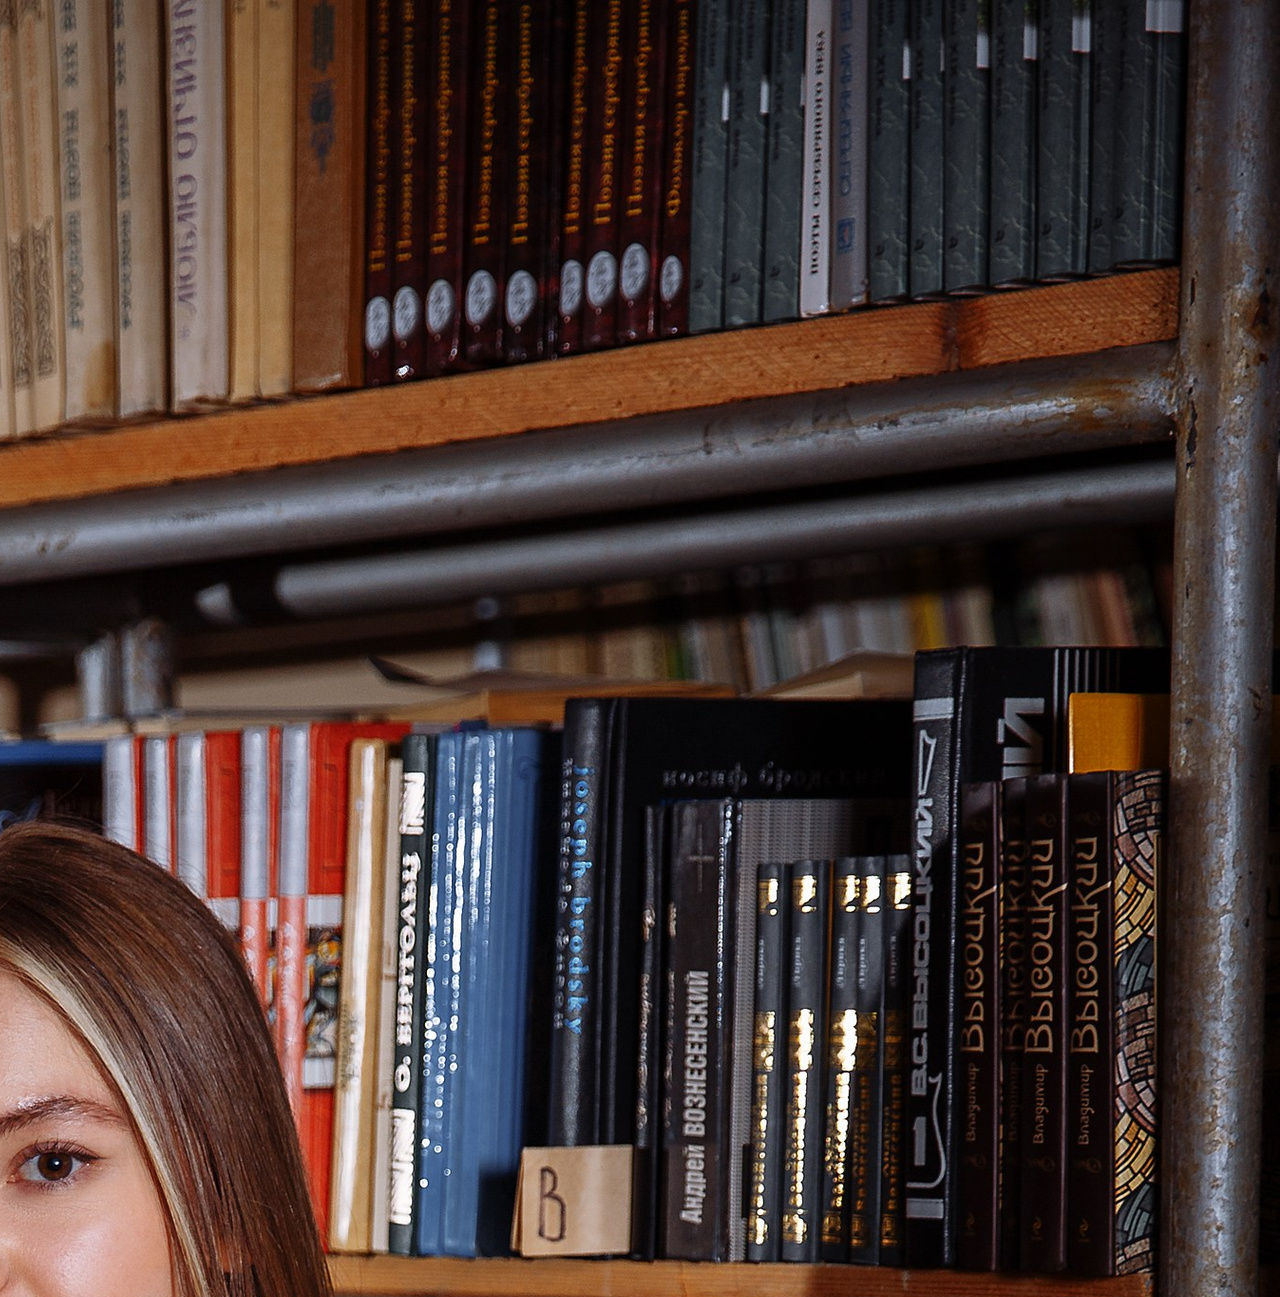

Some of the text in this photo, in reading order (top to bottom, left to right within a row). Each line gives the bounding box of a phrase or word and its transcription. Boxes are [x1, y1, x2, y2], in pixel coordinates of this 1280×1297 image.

[174, 174, 199, 317] ЛЮБЛЮ
[570, 766, 595, 878] joseph
[563, 896, 592, 1036] brodsky
[961, 842, 997, 1053] Высоцкий
[1025, 838, 1068, 1145] Владимир Высоцкий
[1070, 836, 1112, 1146] Владимир Высоцкий
[680, 970, 709, 1226] Андрей ВОЗНЕСЕНСКИЙ
